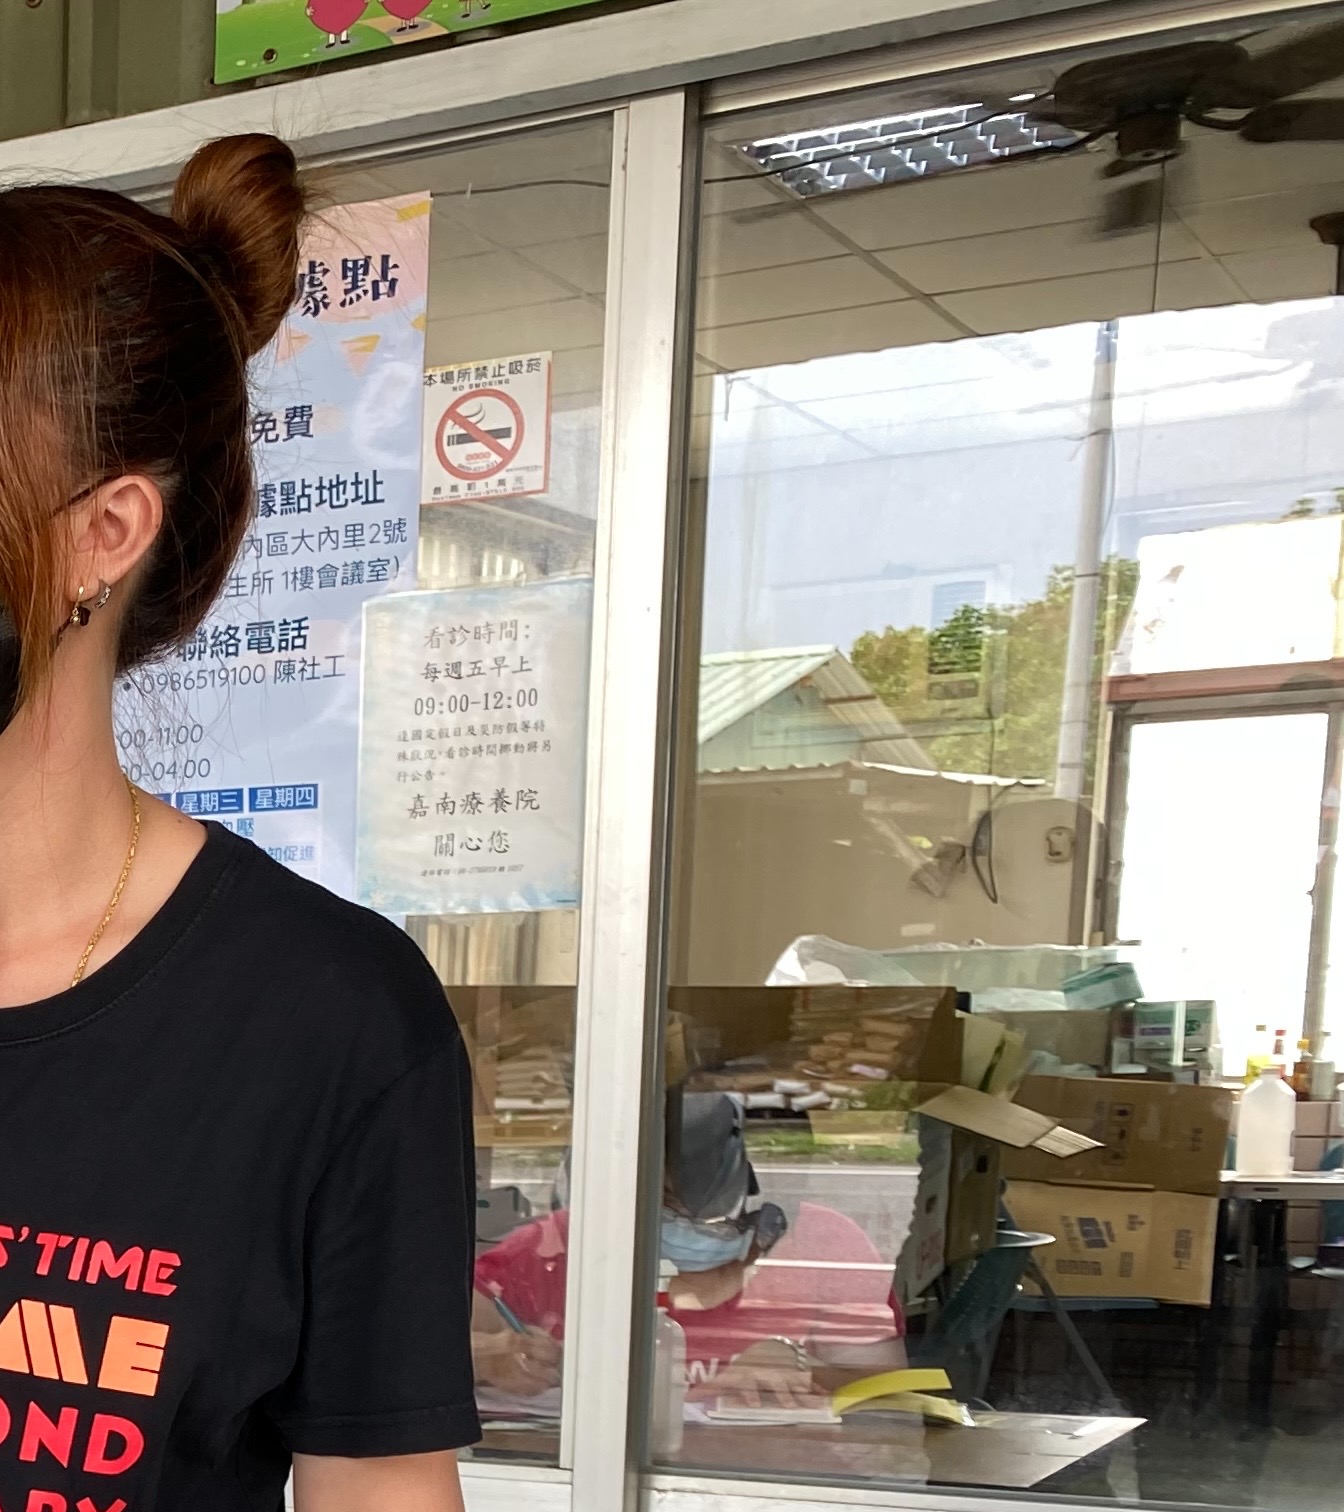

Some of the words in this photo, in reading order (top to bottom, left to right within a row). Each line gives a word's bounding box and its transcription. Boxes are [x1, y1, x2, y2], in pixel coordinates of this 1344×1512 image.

[423, 358, 542, 387] 本場所禁止吸菸
[249, 404, 314, 445] 免費
[178, 617, 310, 662] 聯絡電話
[142, 663, 266, 695] 0986519100
[273, 655, 346, 685] 陳社工
[420, 655, 533, 683] 每週五早上
[414, 688, 538, 716] 09:00-12:00
[181, 791, 240, 813] 星期三
[255, 786, 315, 810] 星期四
[407, 788, 541, 820] 嘉南療養院
[433, 830, 510, 857] 關心您
